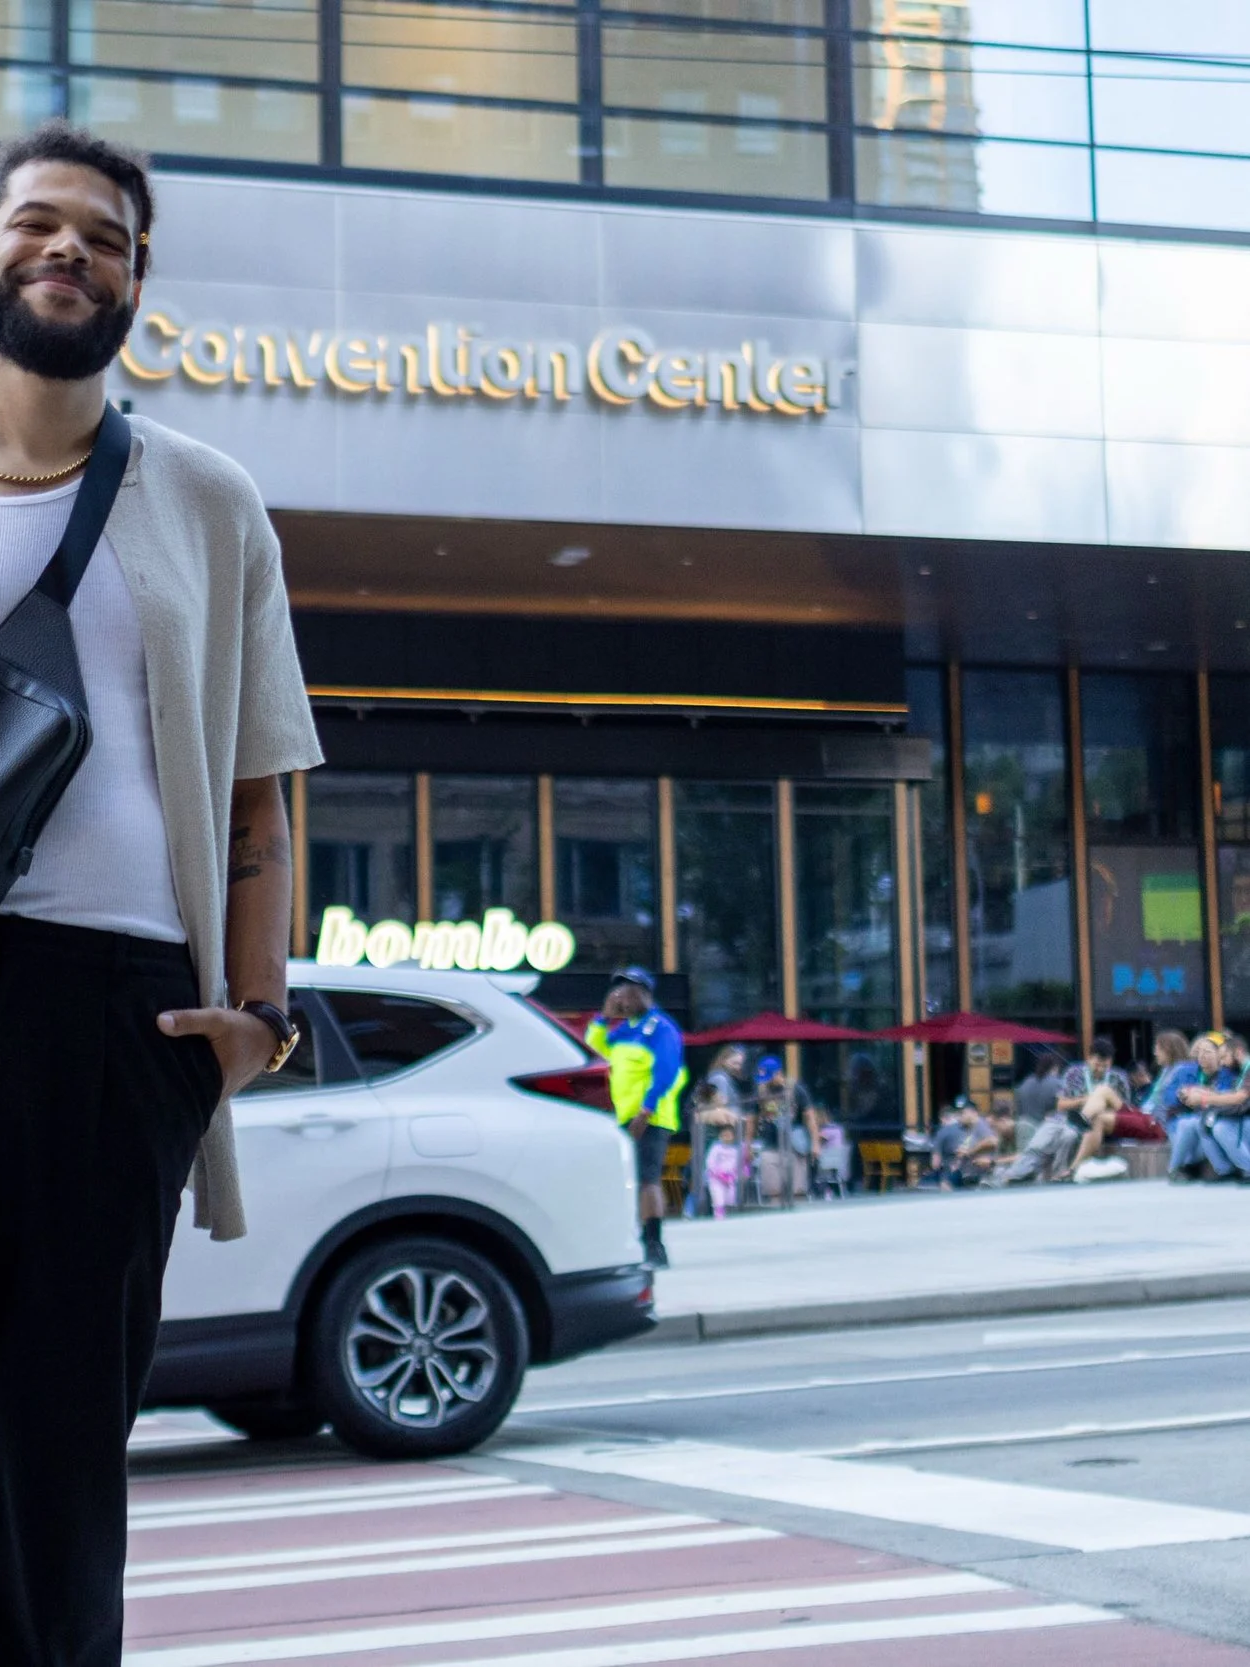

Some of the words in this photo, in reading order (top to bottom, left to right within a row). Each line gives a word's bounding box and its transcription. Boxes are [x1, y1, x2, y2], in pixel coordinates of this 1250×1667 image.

[119, 297, 584, 402] Convention
[588, 325, 859, 416] Center
[316, 904, 576, 972] bombo
